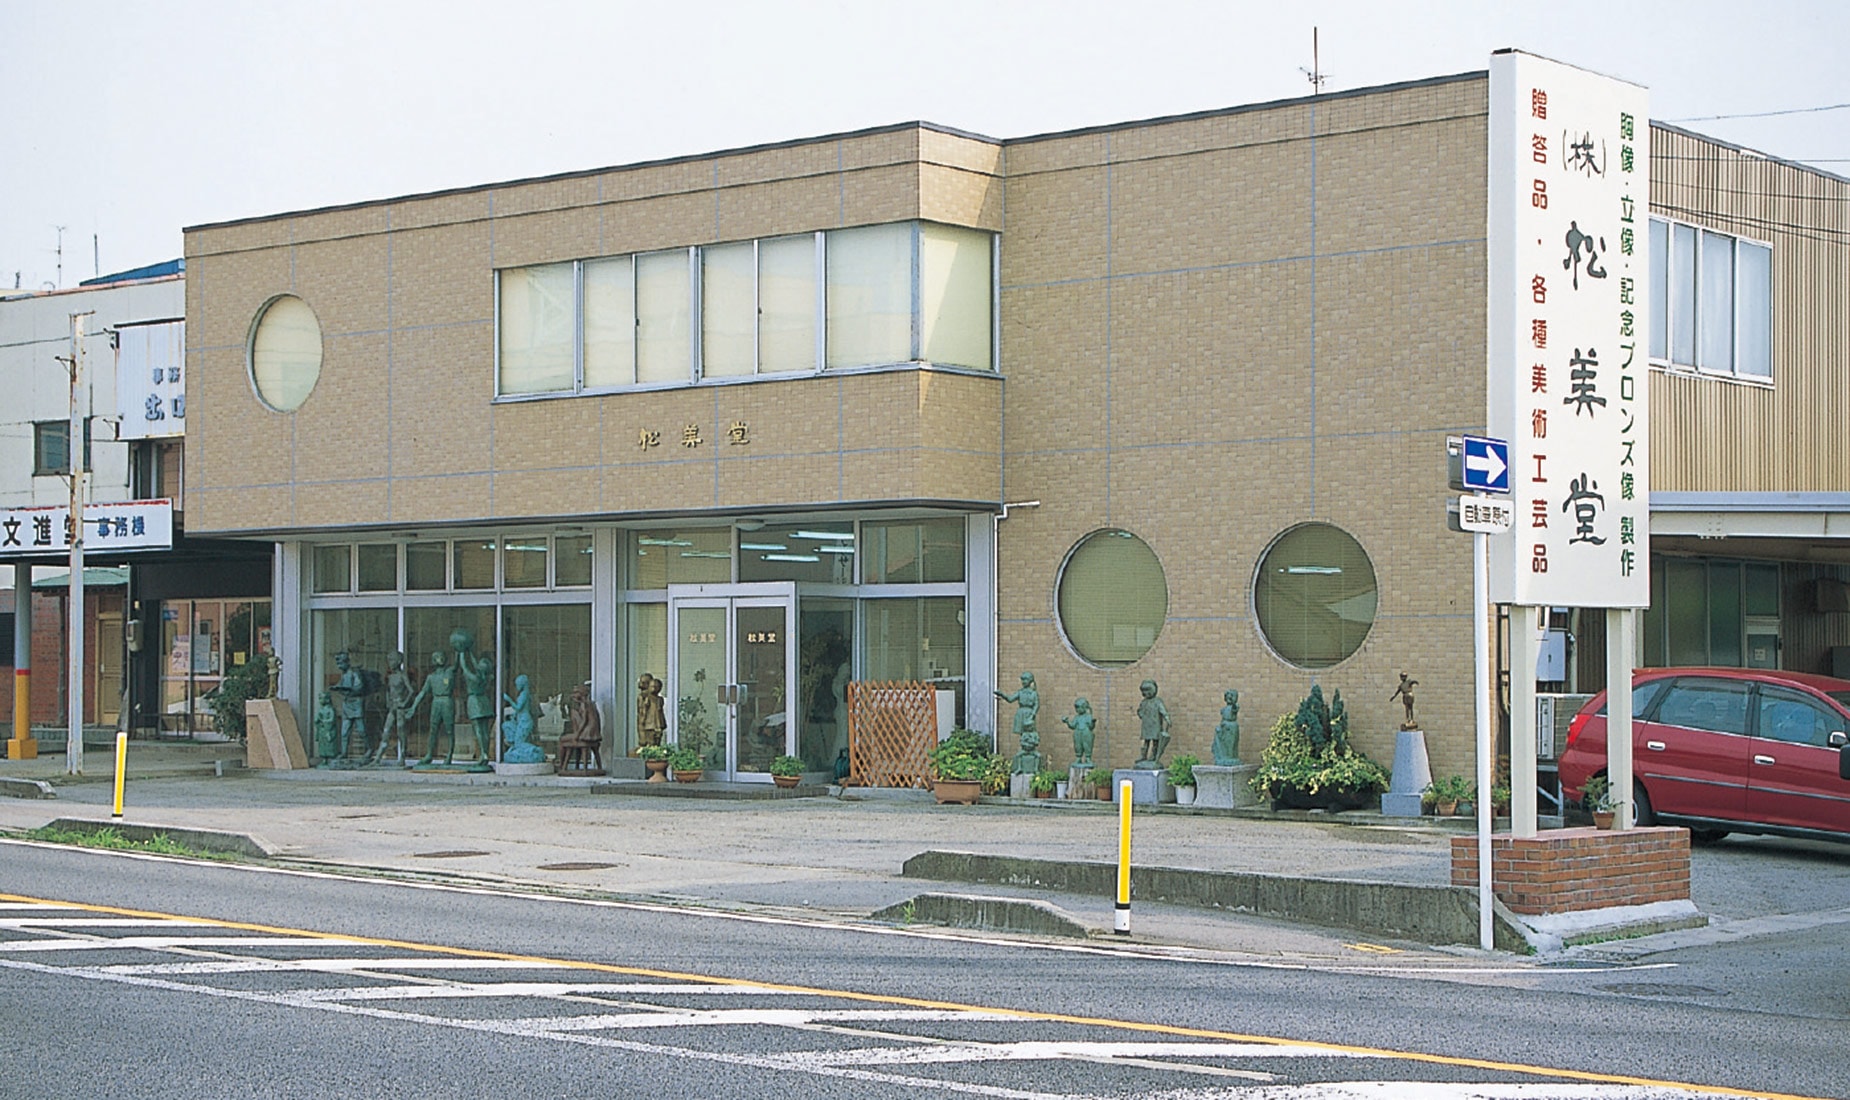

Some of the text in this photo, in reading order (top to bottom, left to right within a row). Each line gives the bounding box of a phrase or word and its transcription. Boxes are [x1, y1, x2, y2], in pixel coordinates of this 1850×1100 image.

[638, 421, 751, 452] 松美堂
[97, 515, 146, 539] 事務機
